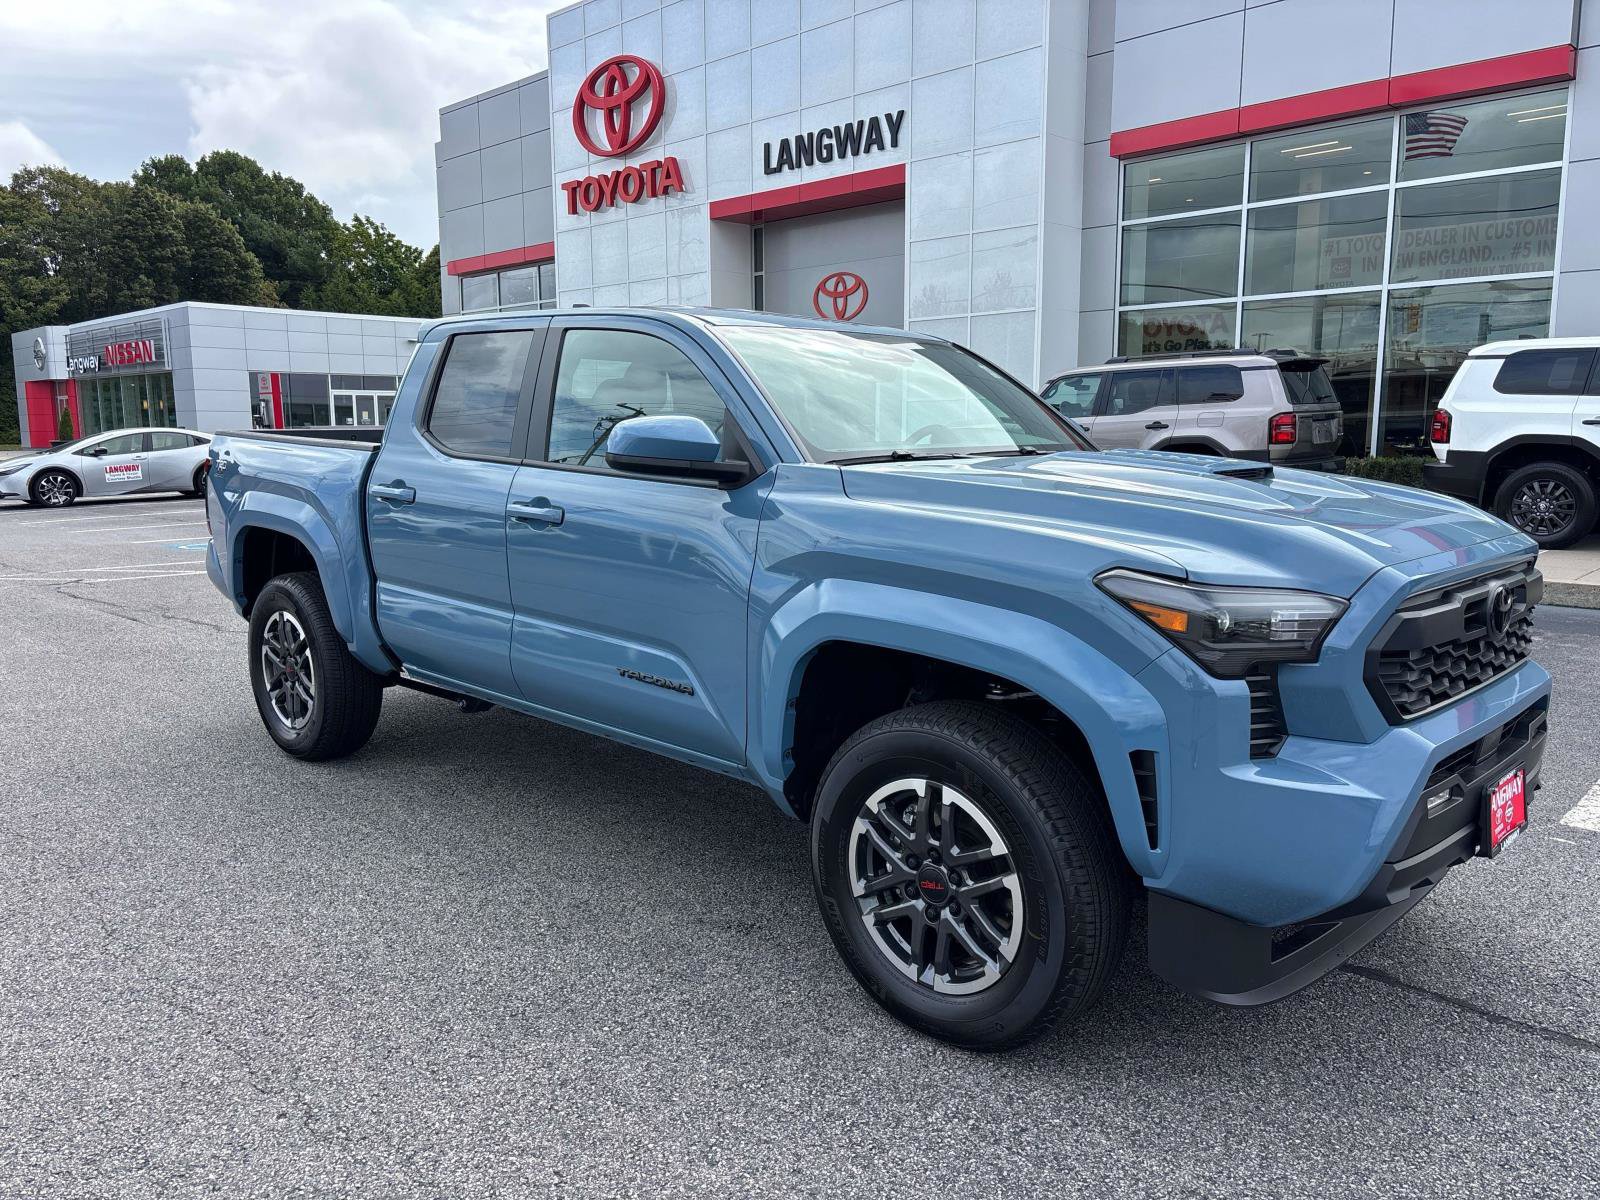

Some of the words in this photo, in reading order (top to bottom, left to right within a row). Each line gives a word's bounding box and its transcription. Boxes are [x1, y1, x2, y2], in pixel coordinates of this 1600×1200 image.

[762, 110, 905, 175] LANGWAY
[561, 156, 686, 216] TOYOTA
[1324, 240, 1340, 257] #1
[1346, 235, 1383, 255] TOYO
[1404, 227, 1457, 249] DEALER
[1462, 225, 1480, 243] IN
[1362, 255, 1378, 272] IN
[1511, 241, 1532, 259] #5
[1537, 238, 1555, 257] IN
[1143, 312, 1231, 338] OYOTA
[66, 355, 101, 373] Langway
[105, 339, 155, 366] NISSAN
[1164, 340, 1182, 351] Go
[104, 464, 140, 474] LANGWAY
[616, 667, 695, 696] TACOMA
[1491, 774, 1524, 812] ANGWAY
[920, 881, 945, 890] TRD
